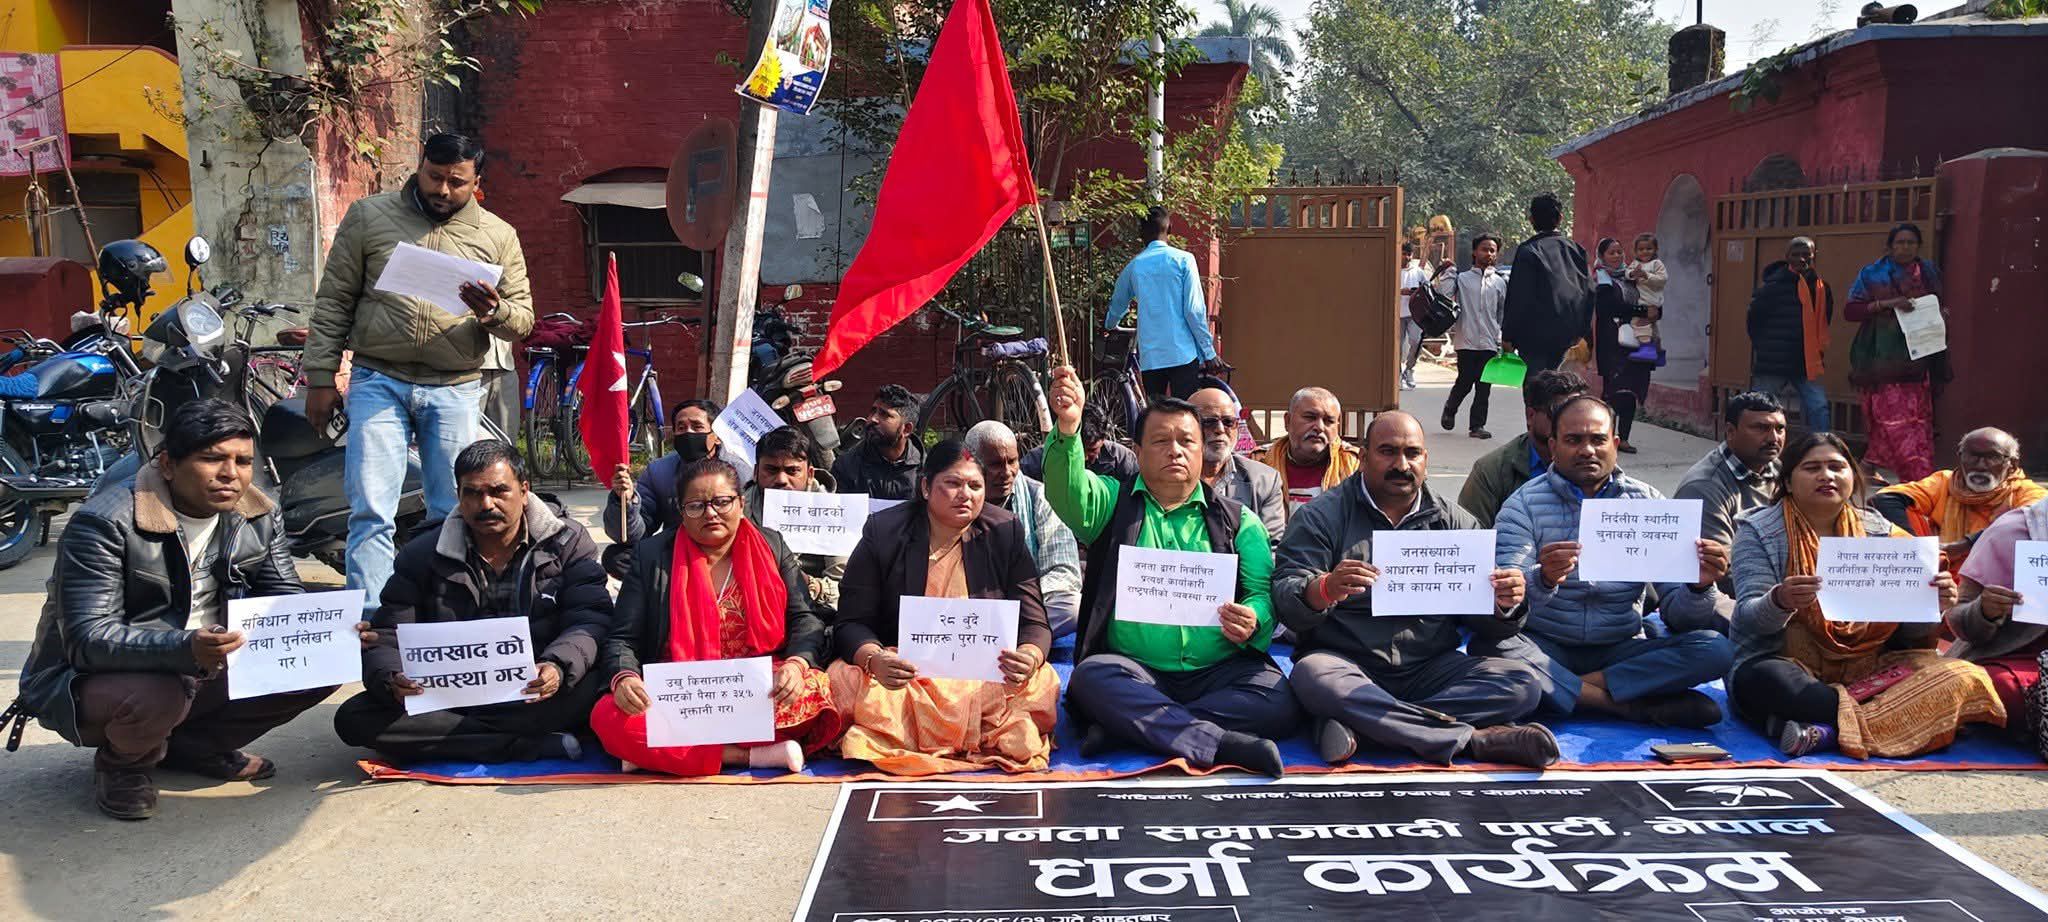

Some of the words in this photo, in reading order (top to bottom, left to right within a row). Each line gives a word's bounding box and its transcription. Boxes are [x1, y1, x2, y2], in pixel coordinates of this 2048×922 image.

[782, 505, 802, 516] मल
[1625, 547, 1640, 556] गर
[1837, 551, 1858, 560] नेपाल
[1134, 562, 1156, 571] जनता
[1385, 564, 1428, 575] आधारमा
[1434, 562, 1476, 575] निर्वाचन
[1387, 580, 1404, 592] क्षेत्र
[1411, 582, 1442, 592] कायम
[1448, 582, 1462, 592] गर
[1206, 594, 1218, 602] गर
[940, 614, 956, 626] २८
[248, 637, 275, 651] तथा
[958, 633, 977, 647] पुरा
[983, 634, 999, 645] गर
[405, 642, 489, 663] मलखाद
[496, 635, 525, 655] को
[278, 656, 296, 669] गर
[494, 666, 528, 683] गर
[697, 688, 716, 700] पैसा
[943, 825, 1124, 844] जनता
[1144, 817, 1463, 843] समाजवादी
[1644, 815, 1835, 836] नेपाल
[1029, 840, 1252, 897] धर्ना
[1287, 837, 1824, 896] कार्यक्रम
